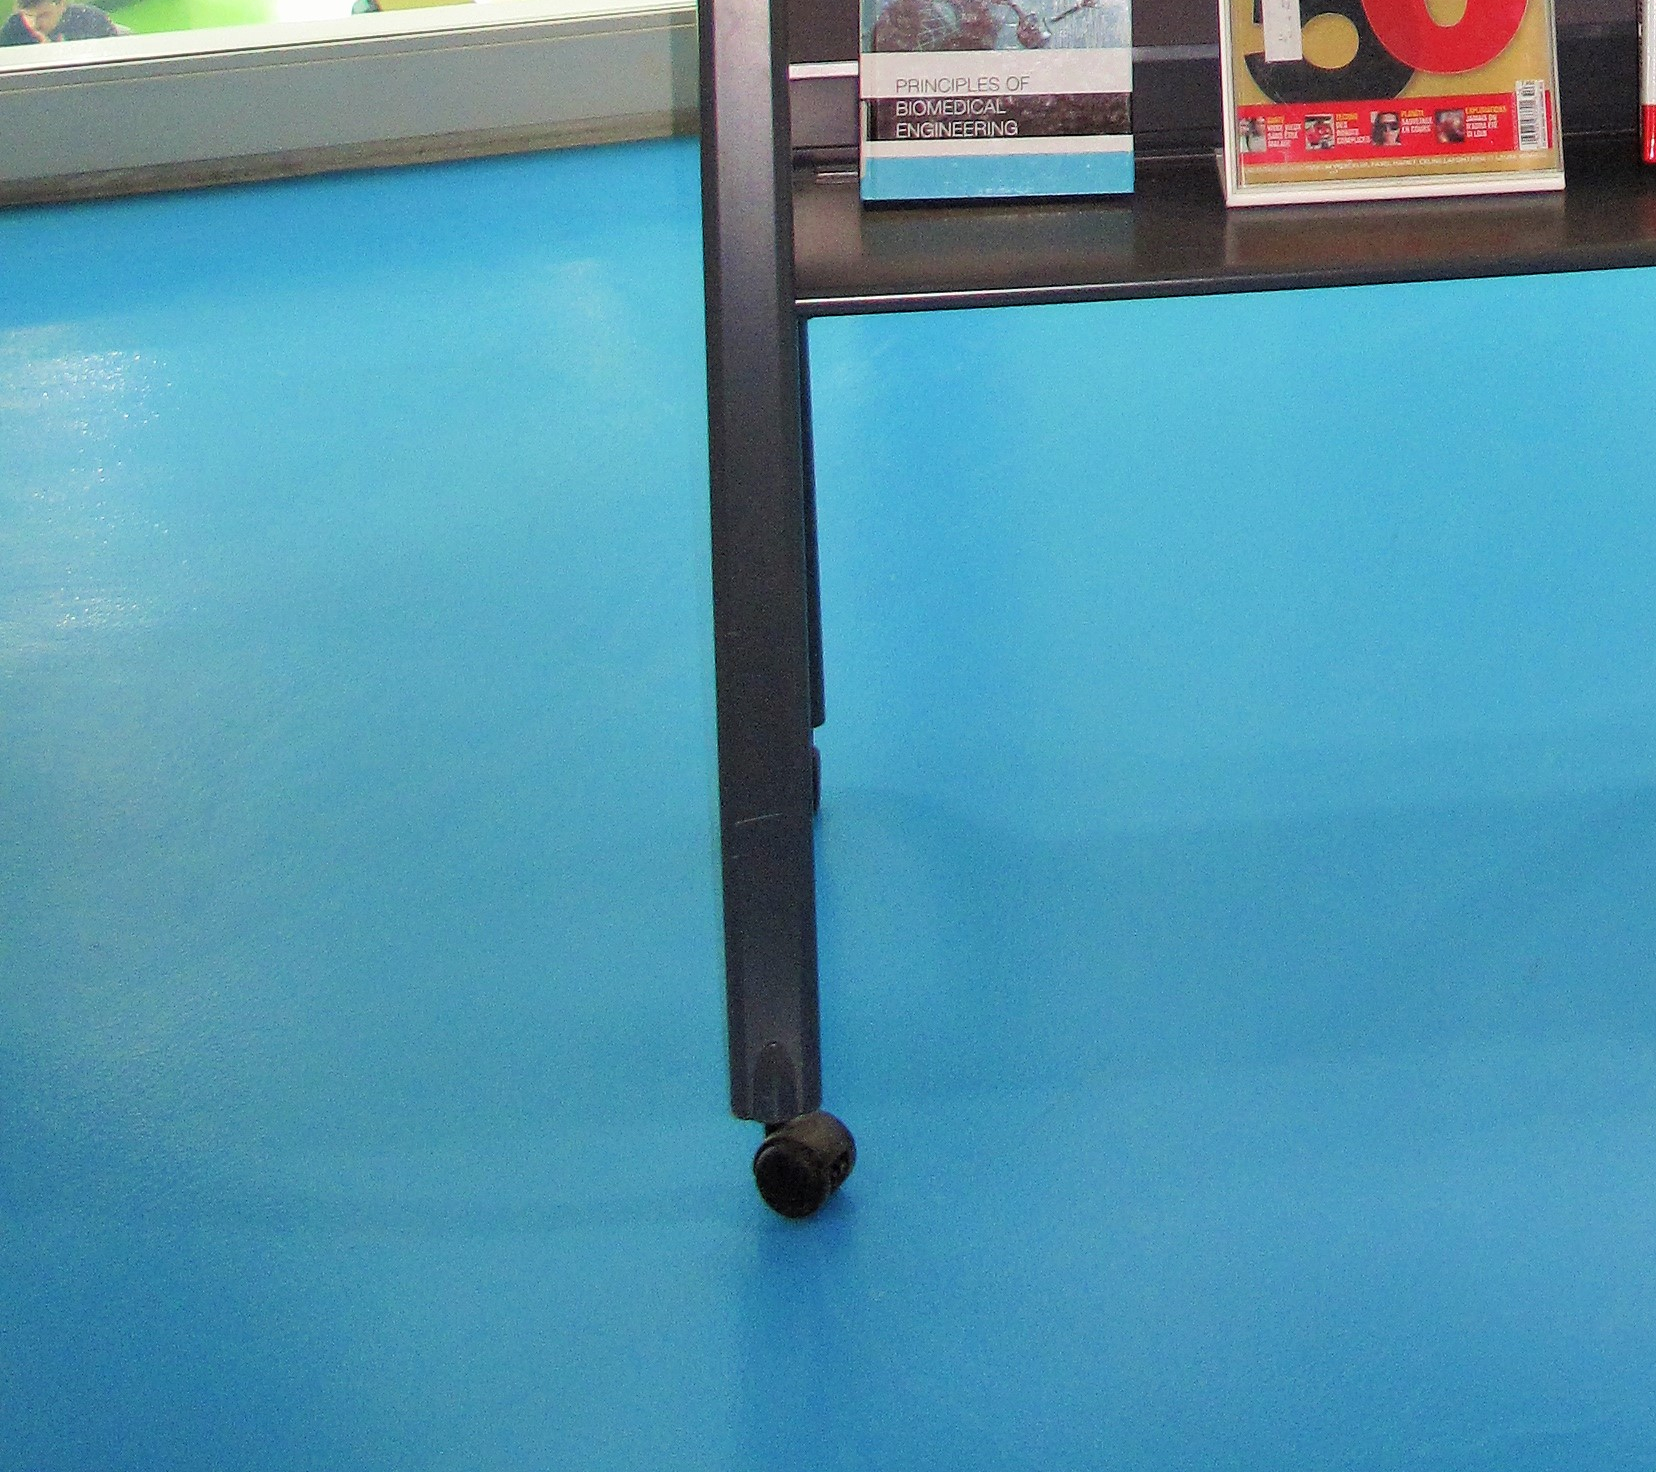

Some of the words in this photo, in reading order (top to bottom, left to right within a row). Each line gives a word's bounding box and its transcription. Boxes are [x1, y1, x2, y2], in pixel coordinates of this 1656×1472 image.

[895, 76, 1000, 94] PRINCIPLES
[1006, 75, 1030, 91] OF
[895, 98, 1007, 117] BIOMEDICAL
[895, 119, 1018, 138] ENGINEERING
